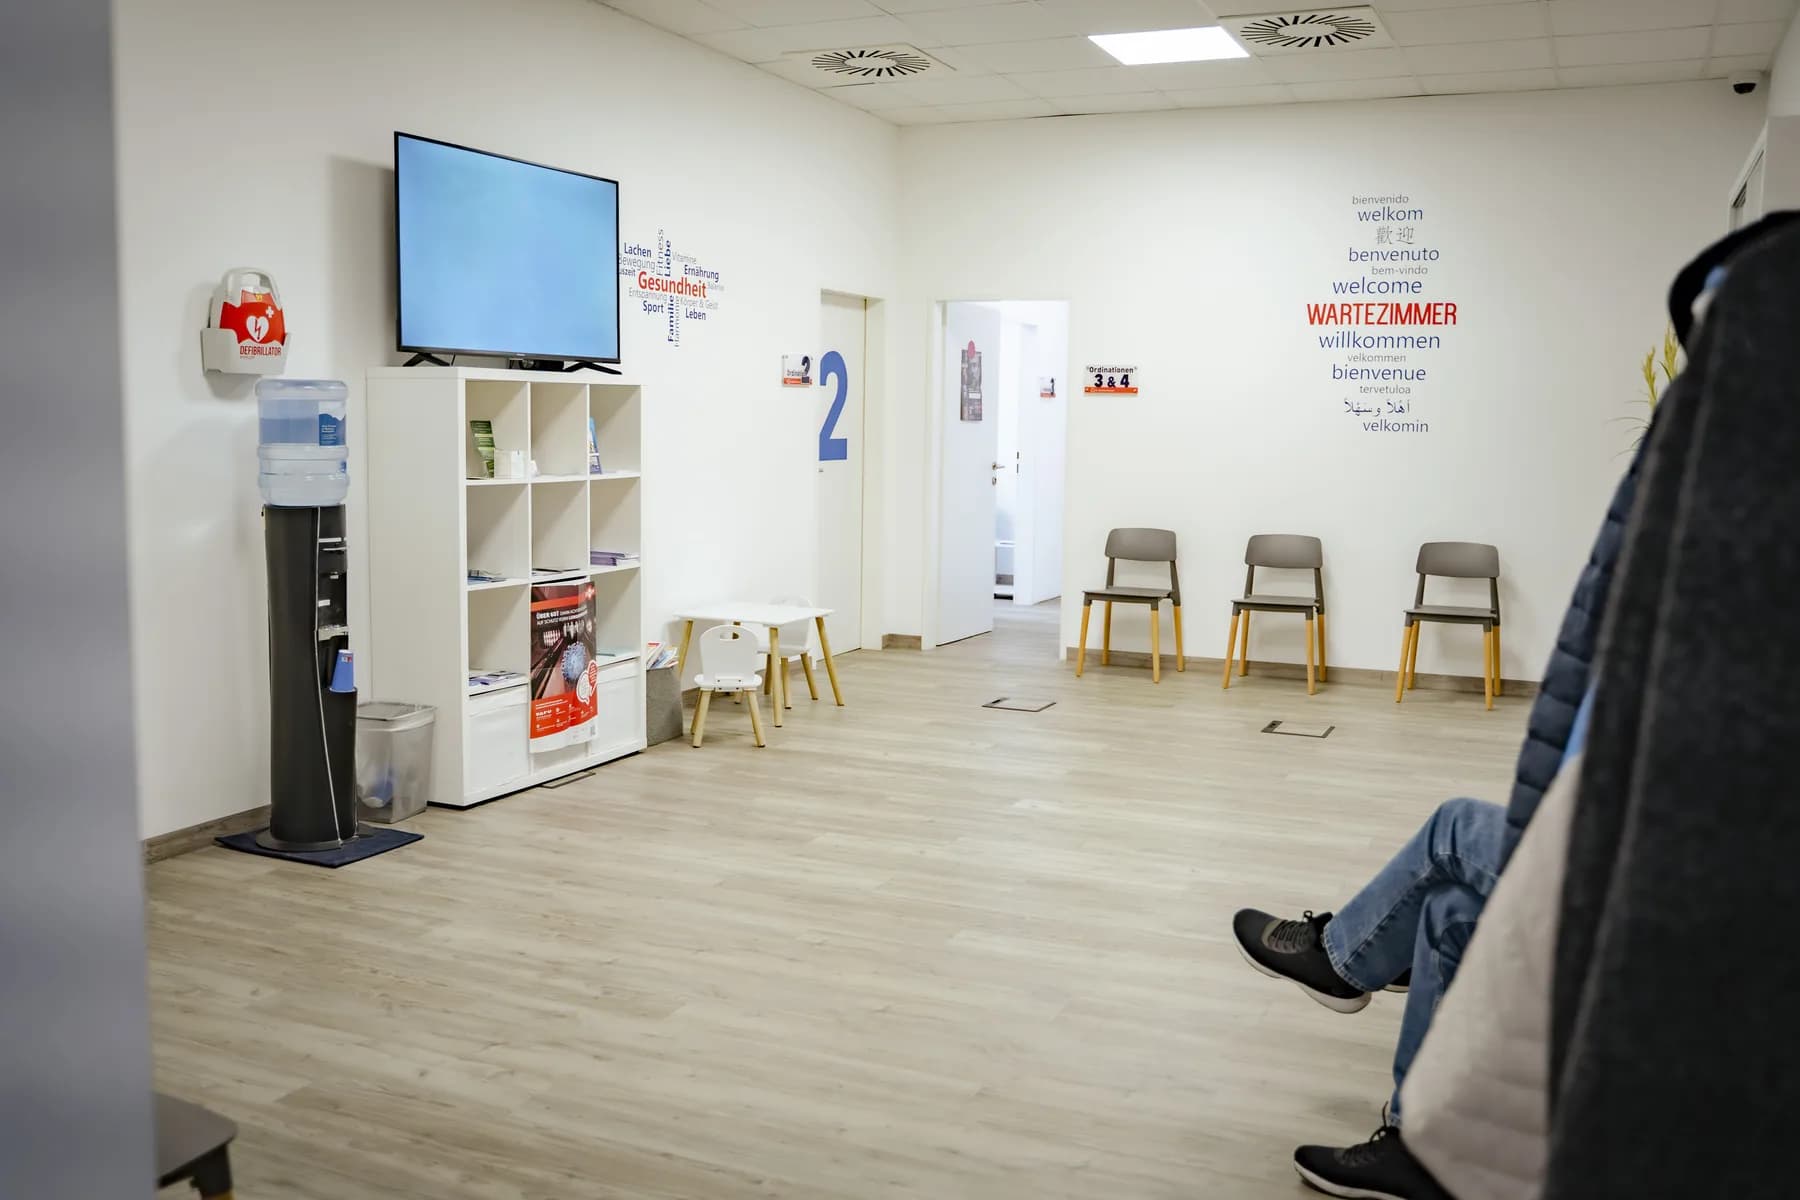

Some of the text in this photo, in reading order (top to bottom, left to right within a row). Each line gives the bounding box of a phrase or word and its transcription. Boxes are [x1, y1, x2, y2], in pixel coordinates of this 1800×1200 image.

[1352, 194, 1409, 205] bienvenido
[1358, 206, 1423, 222] welkom
[1376, 225, 1415, 245] 歡迎
[624, 242, 652, 258] Lachen
[1349, 247, 1440, 262] benvenuto
[684, 264, 719, 283] Ernährung
[1371, 265, 1429, 276] bem-vindo
[638, 271, 707, 299] Gesundheit
[1332, 276, 1423, 294] welcome
[643, 300, 664, 315] Sport
[685, 308, 706, 320] Leben
[1307, 303, 1457, 325] WARTEZIMMER
[1319, 331, 1441, 349] willkommen
[240, 345, 282, 356] DEFIBRILLATOR
[1348, 352, 1407, 363] velkommen
[1332, 364, 1427, 381] bienvenue
[1094, 373, 1130, 388] 3 & 4
[1360, 384, 1411, 394] tervetuloa
[818, 350, 848, 461] 2
[1363, 419, 1429, 433] velkomin
